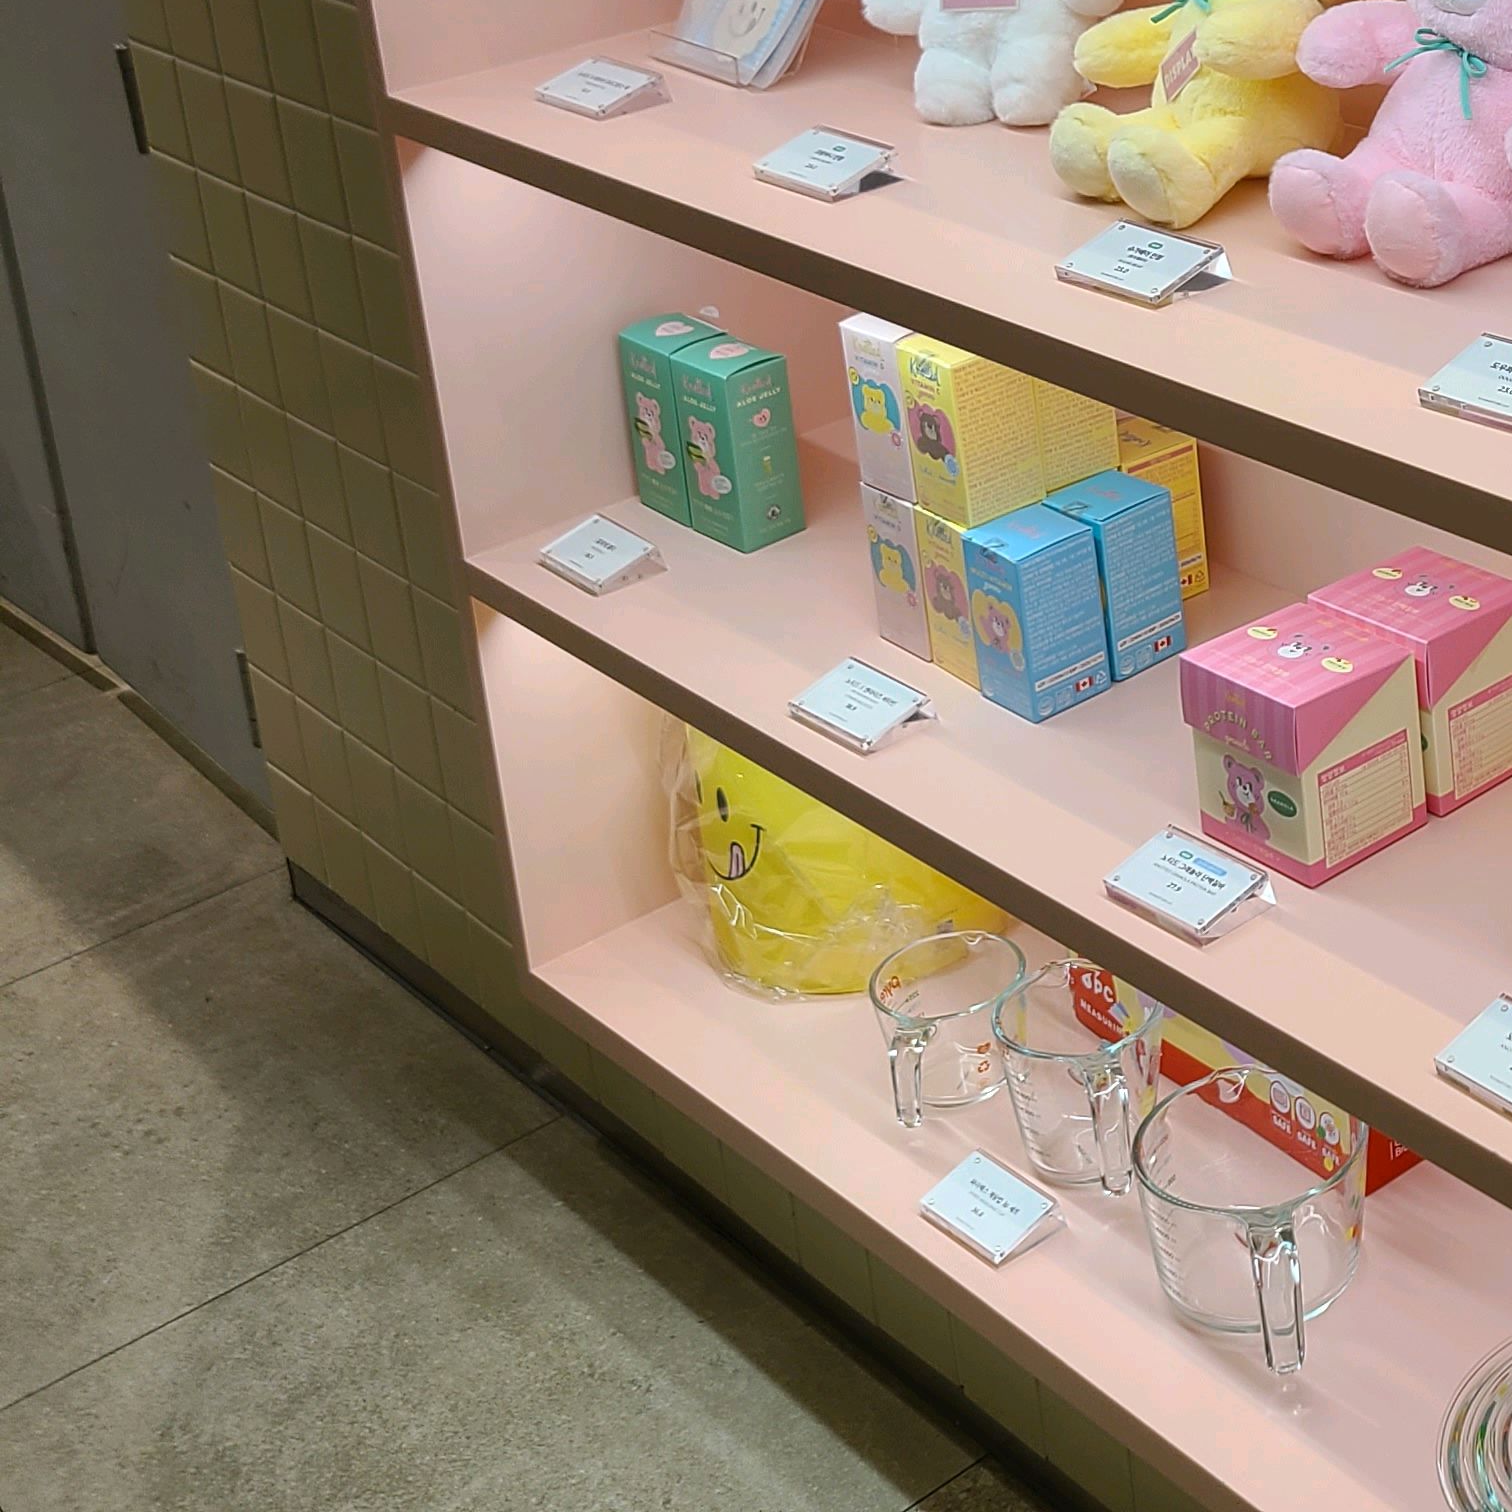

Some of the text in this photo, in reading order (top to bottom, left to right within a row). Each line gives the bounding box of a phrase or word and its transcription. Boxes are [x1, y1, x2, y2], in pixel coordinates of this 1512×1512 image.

[1164, 50, 1196, 88] DISPLA
[736, 386, 781, 408] ALOE JELLY
[1204, 710, 1247, 732] PROTEIN
[1251, 728, 1273, 761] BAR
[1271, 1112, 1293, 1136] SAFE
[1297, 1130, 1318, 1152] SAFE
